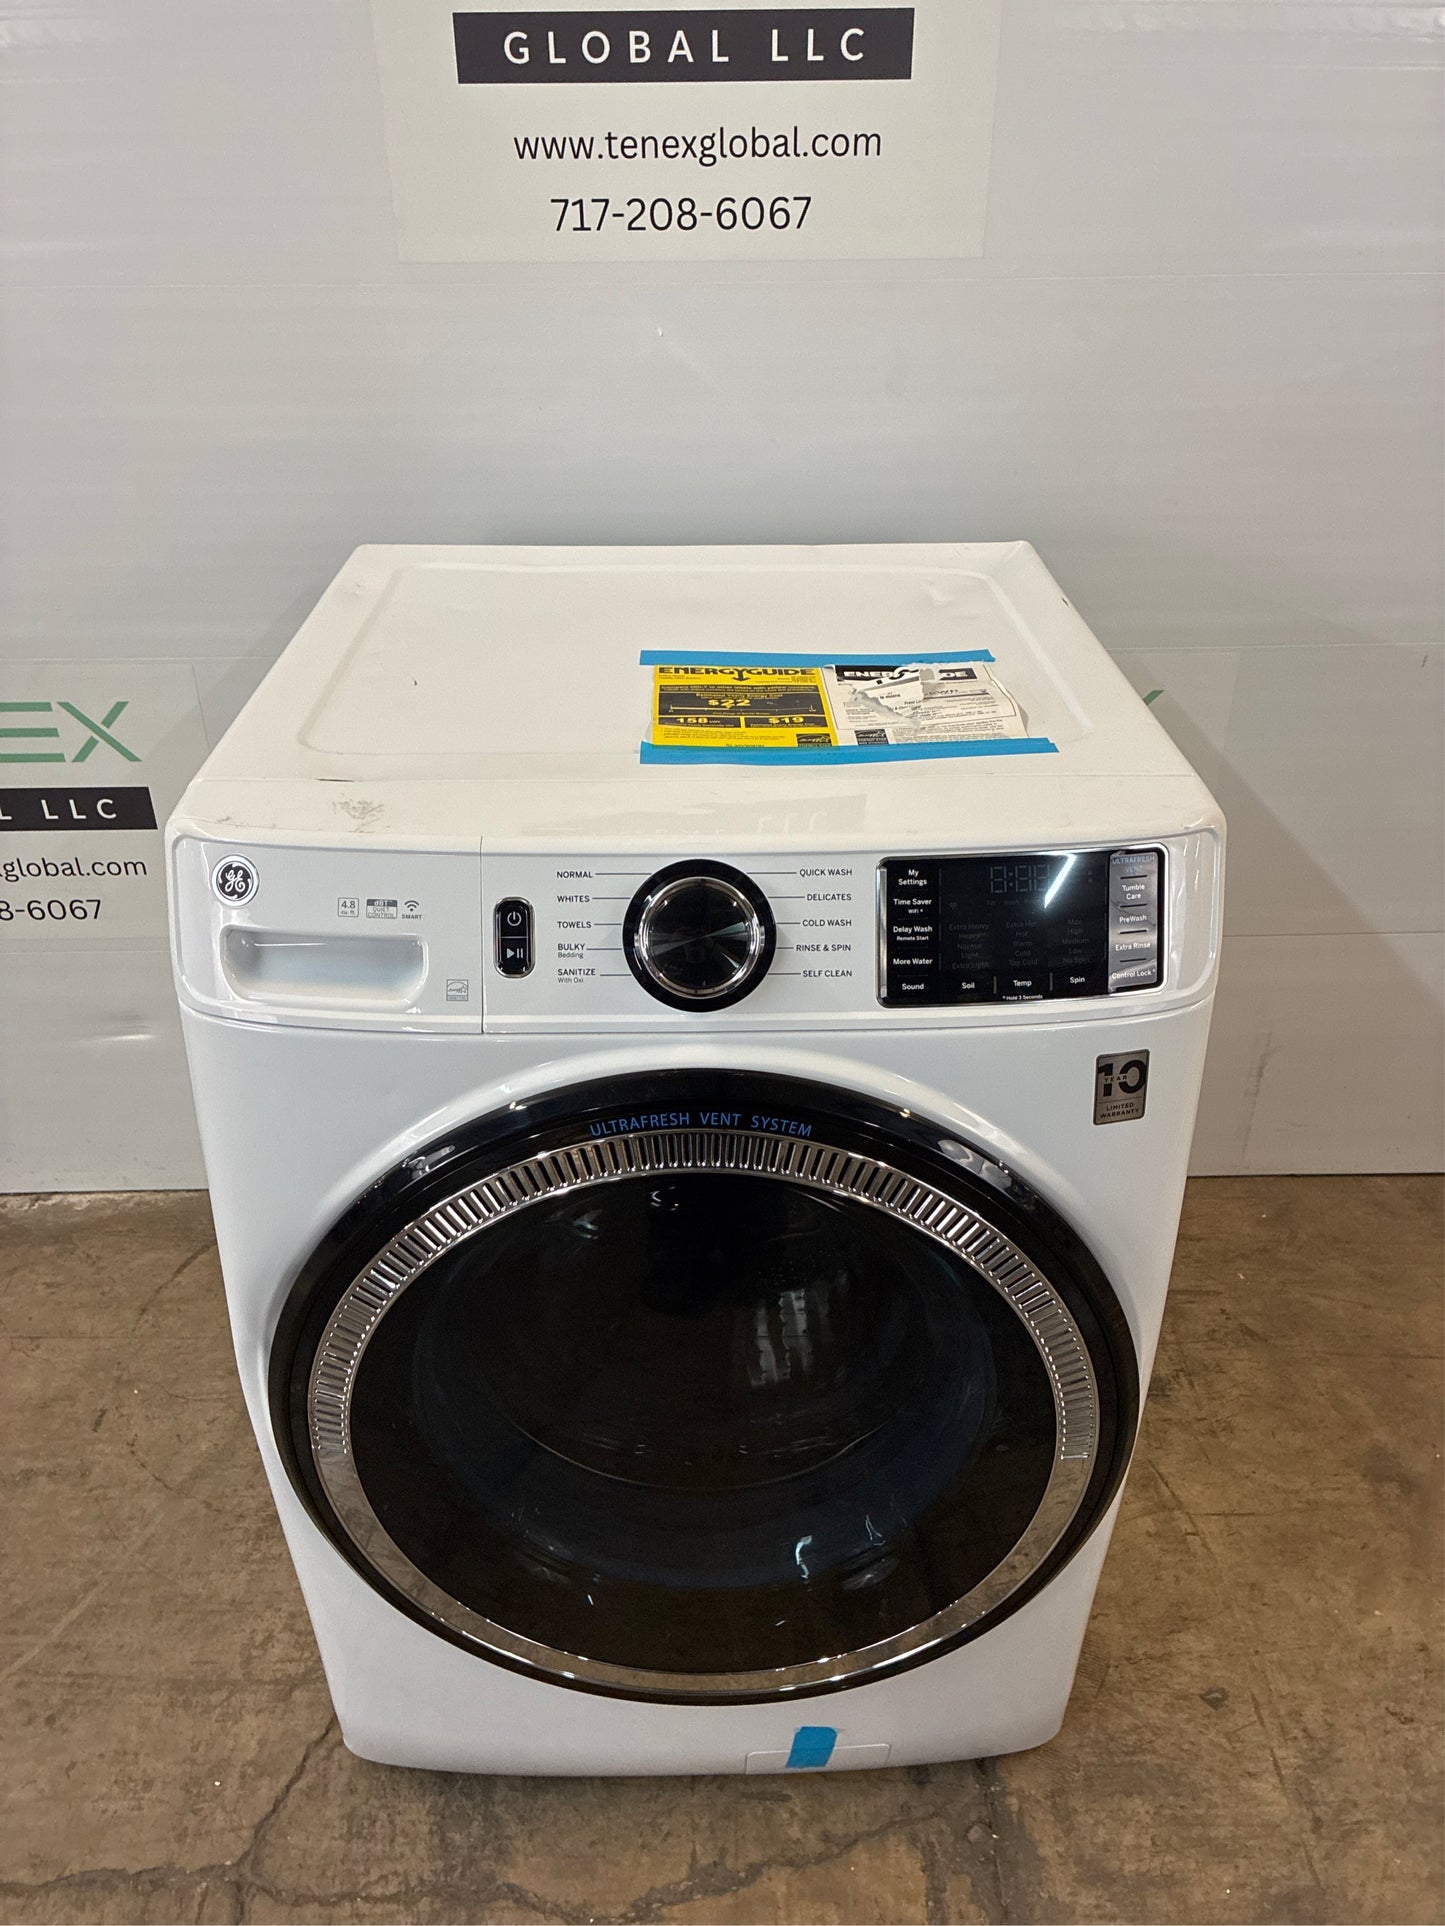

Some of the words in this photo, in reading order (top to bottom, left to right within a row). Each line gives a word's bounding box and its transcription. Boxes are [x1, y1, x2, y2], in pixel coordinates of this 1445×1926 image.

[503, 28, 729, 65] GLOBAL
[771, 26, 866, 62] LLC
[513, 126, 883, 167] www.tenexglobal.com
[549, 196, 813, 231] 717-208-6067
[659, 667, 815, 679] ENERGYGUIDE
[768, 716, 804, 724] $19
[40, 799, 117, 820] LLC
[0, 857, 147, 882] global.com
[800, 869, 826, 877] QUICK
[908, 869, 919, 877] My
[556, 871, 593, 879] NORMAL
[898, 878, 928, 886] Settings
[1122, 884, 1145, 892] Tumble
[341, 900, 356, 909] 4.8
[802, 919, 826, 927] COLD
[1119, 914, 1147, 924] PreWash
[557, 921, 592, 929] TOWELS
[893, 926, 912, 934] Delay
[557, 943, 586, 951] BULKY
[796, 944, 821, 952] RINSE
[823, 944, 830, 952] &
[1133, 941, 1151, 949] Rinse
[557, 968, 596, 976] SANITIZE
[803, 970, 823, 978] SELF
[1112, 971, 1135, 980] Control
[1137, 969, 1152, 977] Lock
[1069, 976, 1085, 984] Spin
[1098, 1060, 1147, 1096] 10
[1106, 1102, 1134, 1111] LIMITED
[1100, 1108, 1139, 1118] WARRANTY
[589, 1112, 690, 1137] ULTRAFRESH
[700, 1112, 742, 1127] VENT
[750, 1115, 813, 1137] SYSTEM
